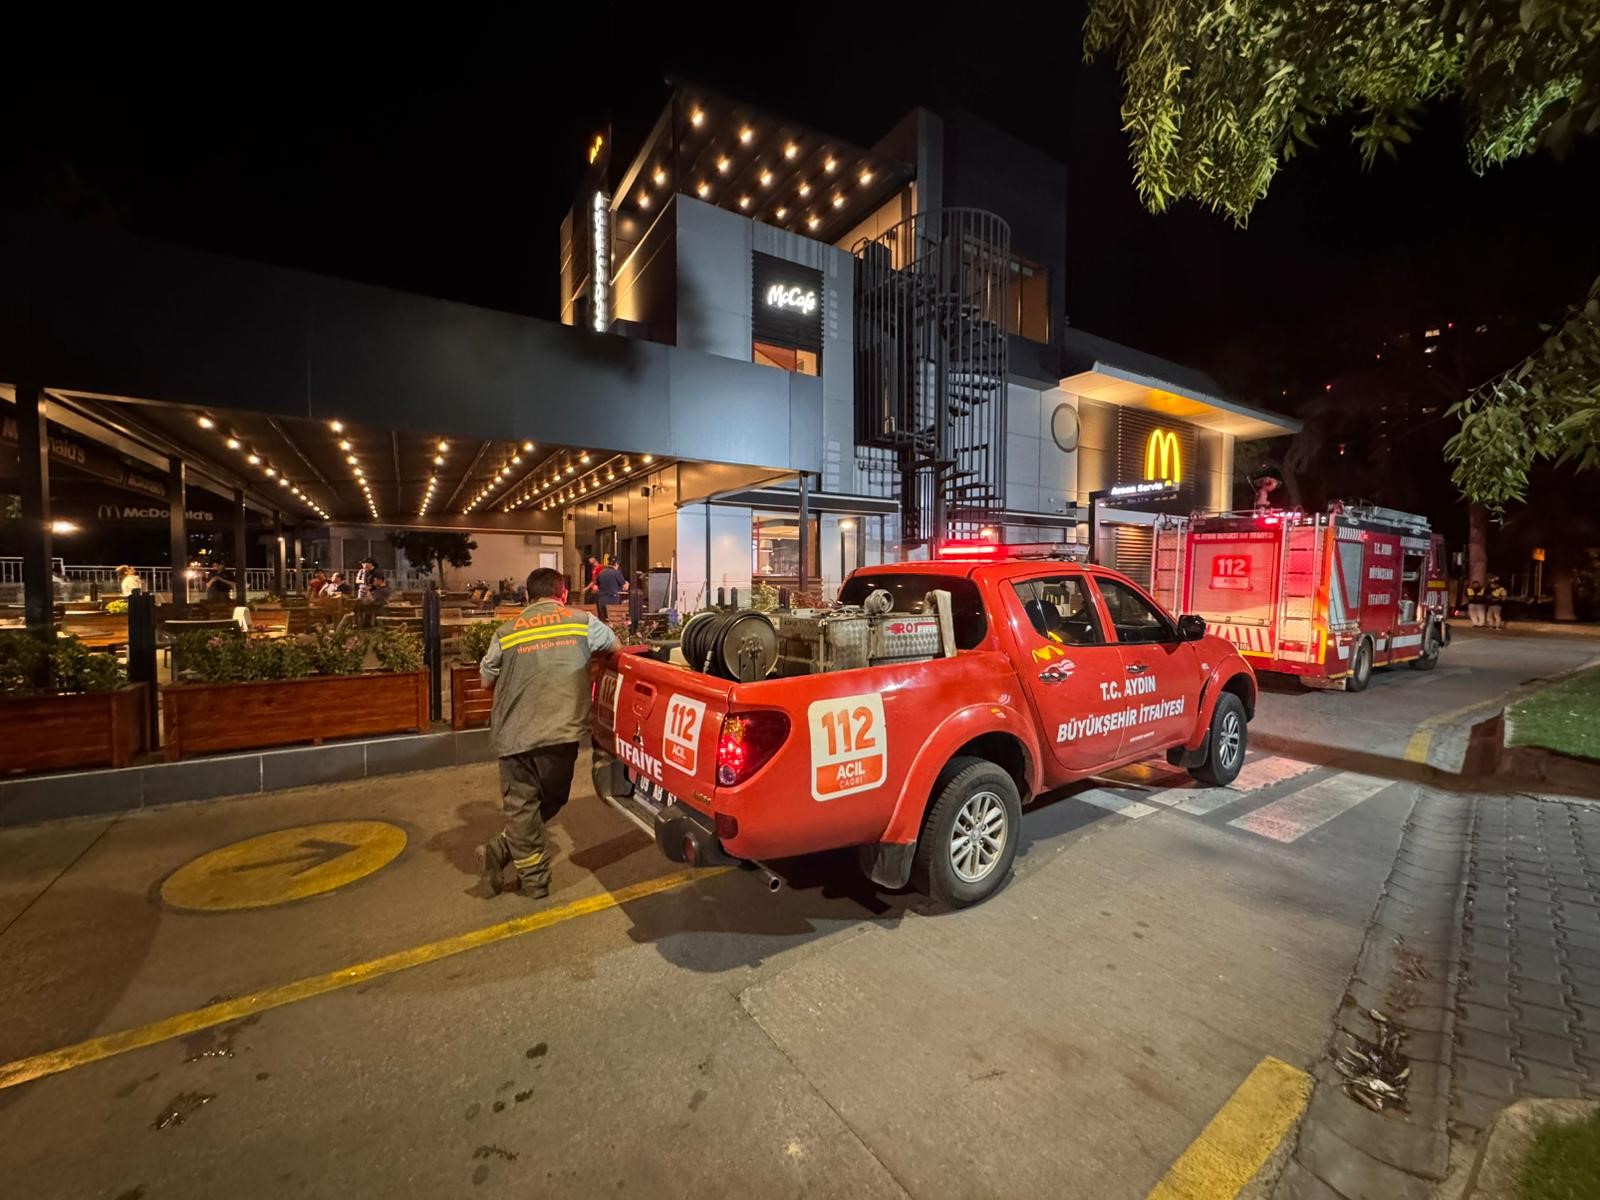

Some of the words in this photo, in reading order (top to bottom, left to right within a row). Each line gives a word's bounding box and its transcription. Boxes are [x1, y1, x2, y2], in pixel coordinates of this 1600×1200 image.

[1217, 558, 1246, 576] 112
[1100, 680, 1121, 701] T.C.
[1124, 675, 1156, 697] AYDIN
[671, 703, 696, 742] 112
[821, 706, 875, 756] 112
[1056, 706, 1137, 743] BÜYÜKŞEHİR
[1139, 695, 1185, 724] İTFAİYESİ
